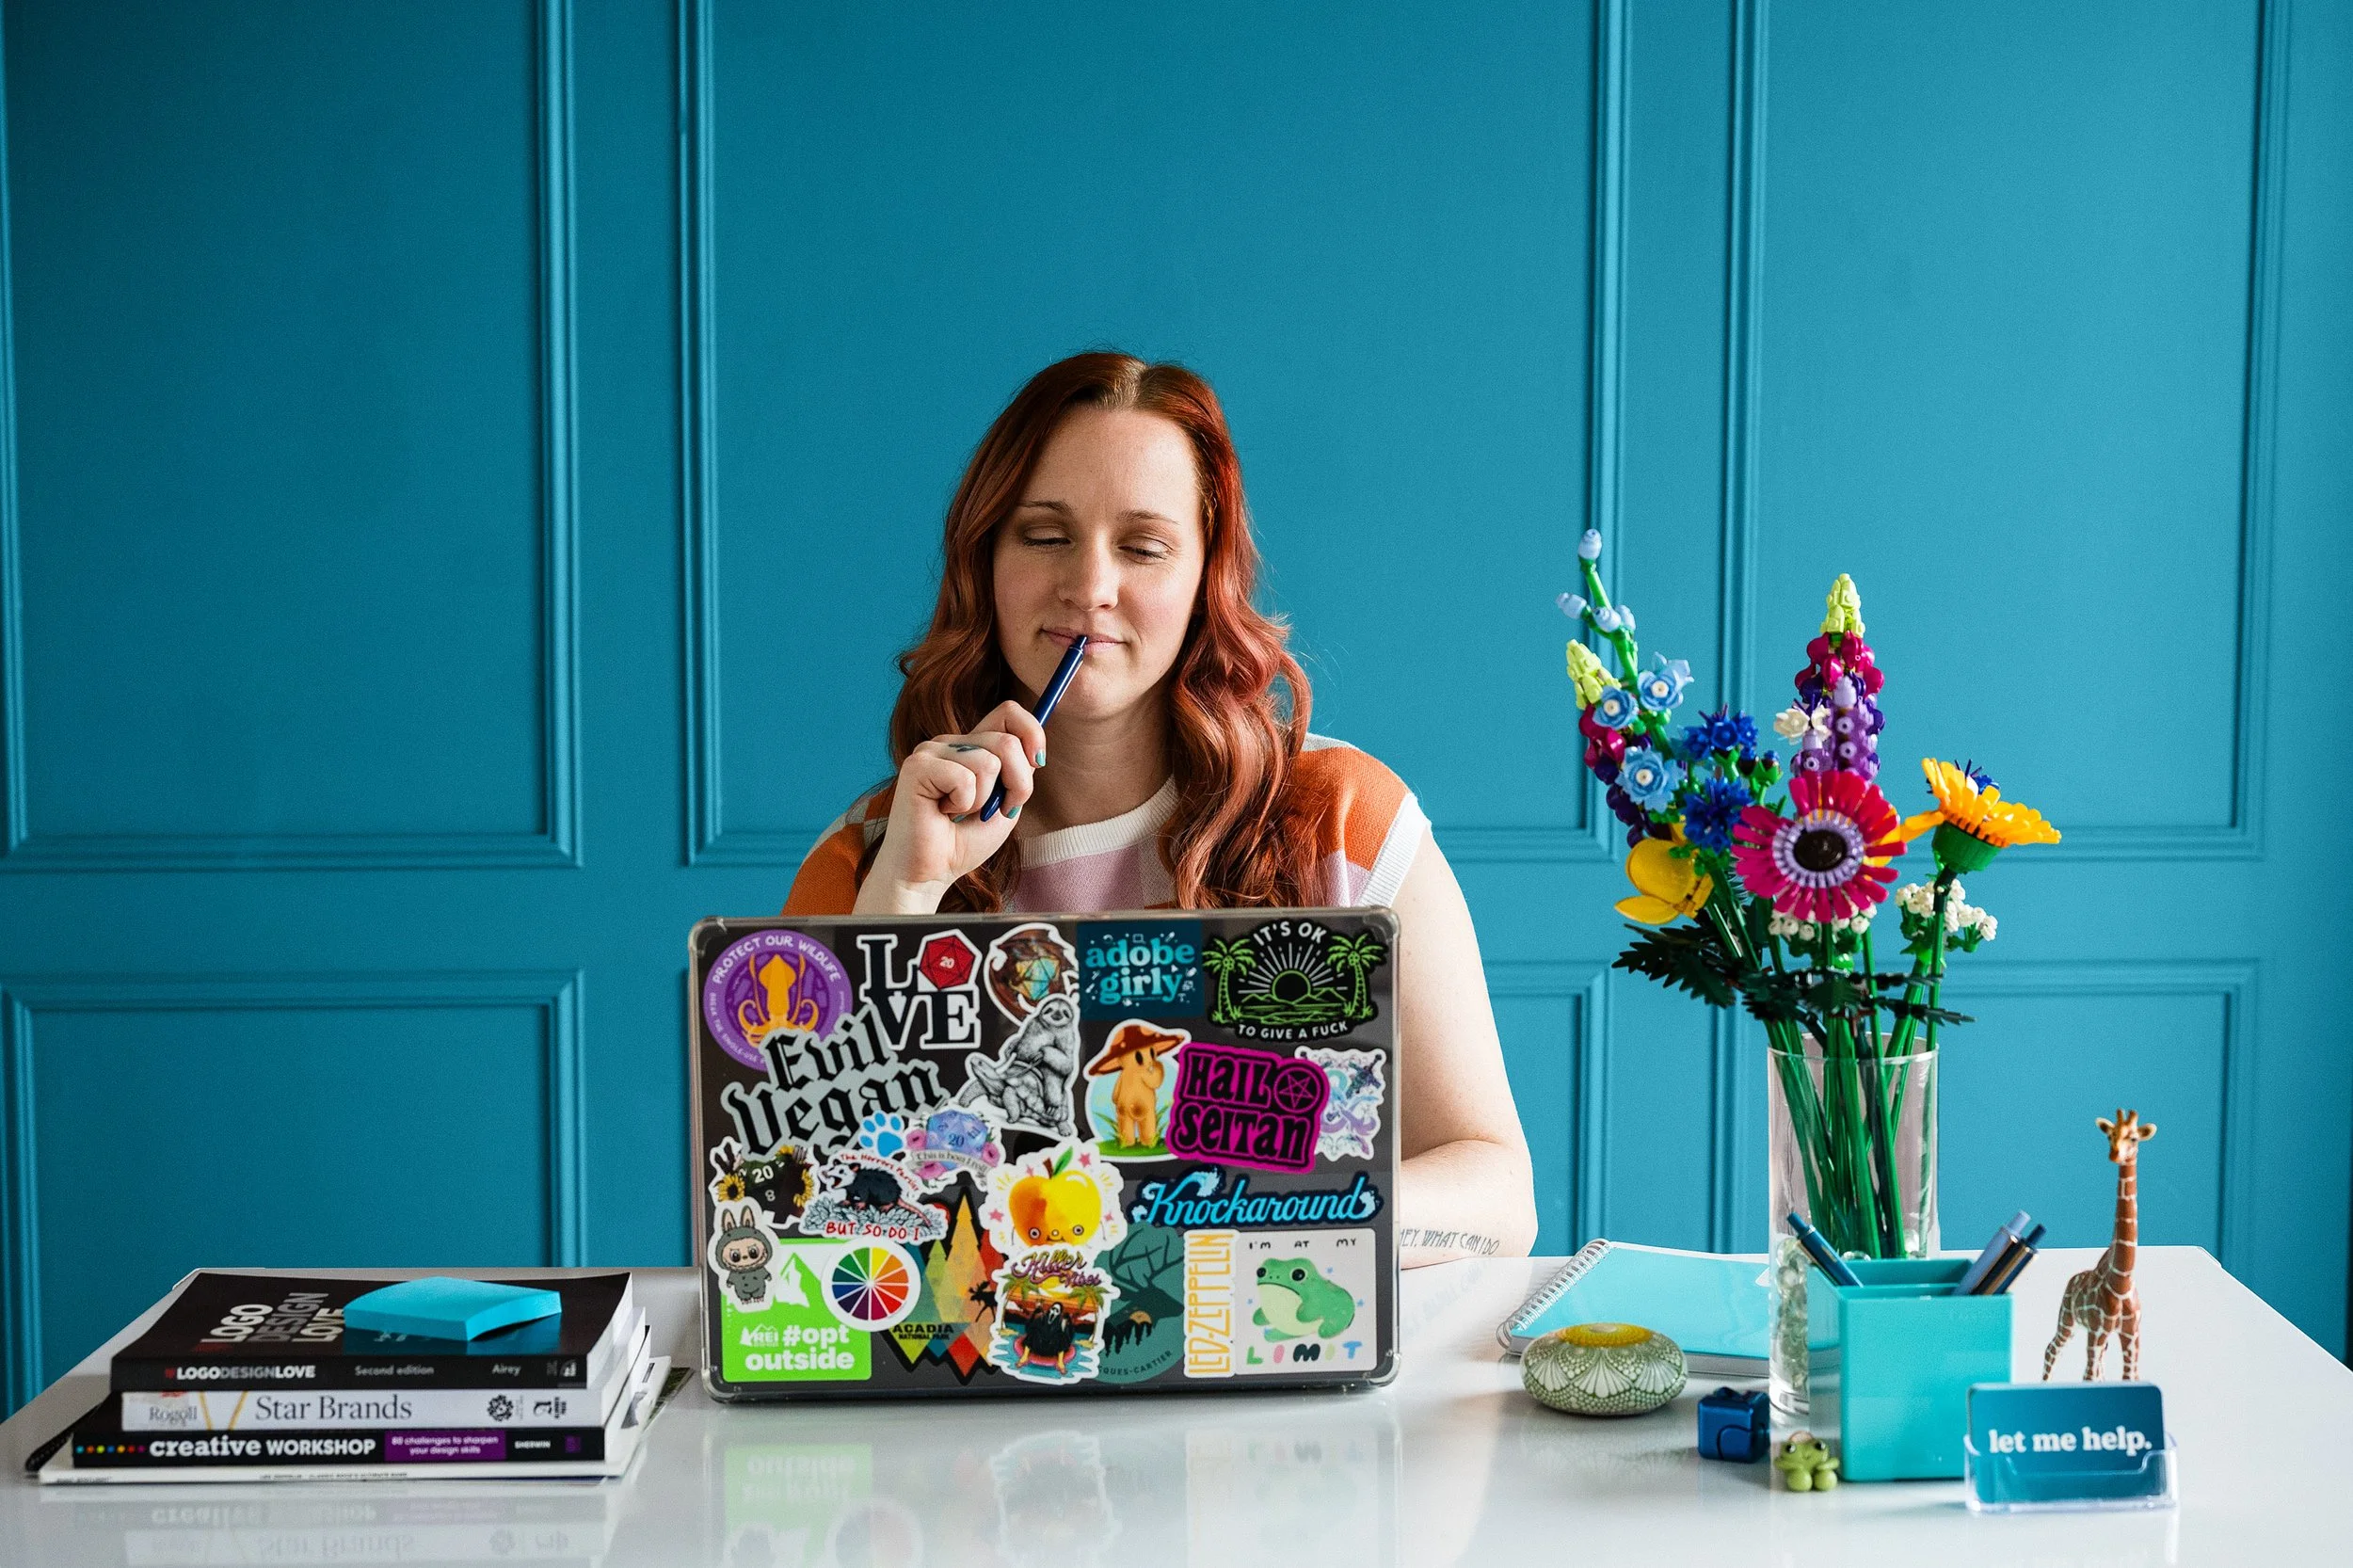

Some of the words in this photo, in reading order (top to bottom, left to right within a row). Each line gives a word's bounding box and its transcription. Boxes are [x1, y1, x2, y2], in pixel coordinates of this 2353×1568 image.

[1253, 921, 1291, 946] IT'S
[1298, 922, 1327, 944] OK
[712, 937, 760, 984] PROTECT
[765, 936, 794, 947] OUR
[798, 940, 841, 983] WILDLIFE
[1085, 937, 1195, 968] adobe
[1099, 967, 1183, 1005] girly
[1238, 1024, 1256, 1036] TO
[1260, 1028, 1292, 1039] GIVE
[1298, 1028, 1307, 1039] A
[1312, 1021, 1348, 1036] FUCK
[765, 1010, 891, 1092] Evil
[728, 1066, 943, 1155] Vegan
[948, 1133, 965, 1147] 20
[752, 1165, 774, 1184] 20
[765, 1189, 776, 1202] 8
[1132, 1170, 1377, 1225] Knockaround
[825, 1222, 856, 1235] BUT
[862, 1224, 882, 1237] SO
[888, 1225, 907, 1239] DO
[914, 1227, 920, 1240] I
[1249, 1240, 1271, 1250] I'M
[1336, 1238, 1356, 1247] MY
[1421, 1229, 1459, 1249] WHAT
[1461, 1232, 1481, 1254] CAN
[1481, 1239, 1500, 1256] DO
[1011, 1249, 1087, 1284] Killer
[200, 1304, 274, 1343] LOGO
[247, 1292, 329, 1343] DESIGN
[292, 1307, 344, 1343] LOVE
[892, 1324, 954, 1333] ACADIA
[783, 1324, 850, 1350] #opt
[355, 1366, 393, 1377] Second
[396, 1365, 435, 1376] edition
[492, 1364, 521, 1376] Airey
[744, 1347, 855, 1371] outside
[255, 1395, 311, 1420] Star
[319, 1394, 412, 1420] Brands
[150, 1435, 262, 1458] creative
[266, 1438, 376, 1456] WORKSHOP
[404, 1436, 452, 1447] challenges
[453, 1436, 462, 1445] to
[409, 1447, 428, 1456] your
[430, 1446, 459, 1456] design
[1989, 1429, 2027, 1454] let
[2032, 1432, 2077, 1453] me
[2081, 1425, 2153, 1457] help.
